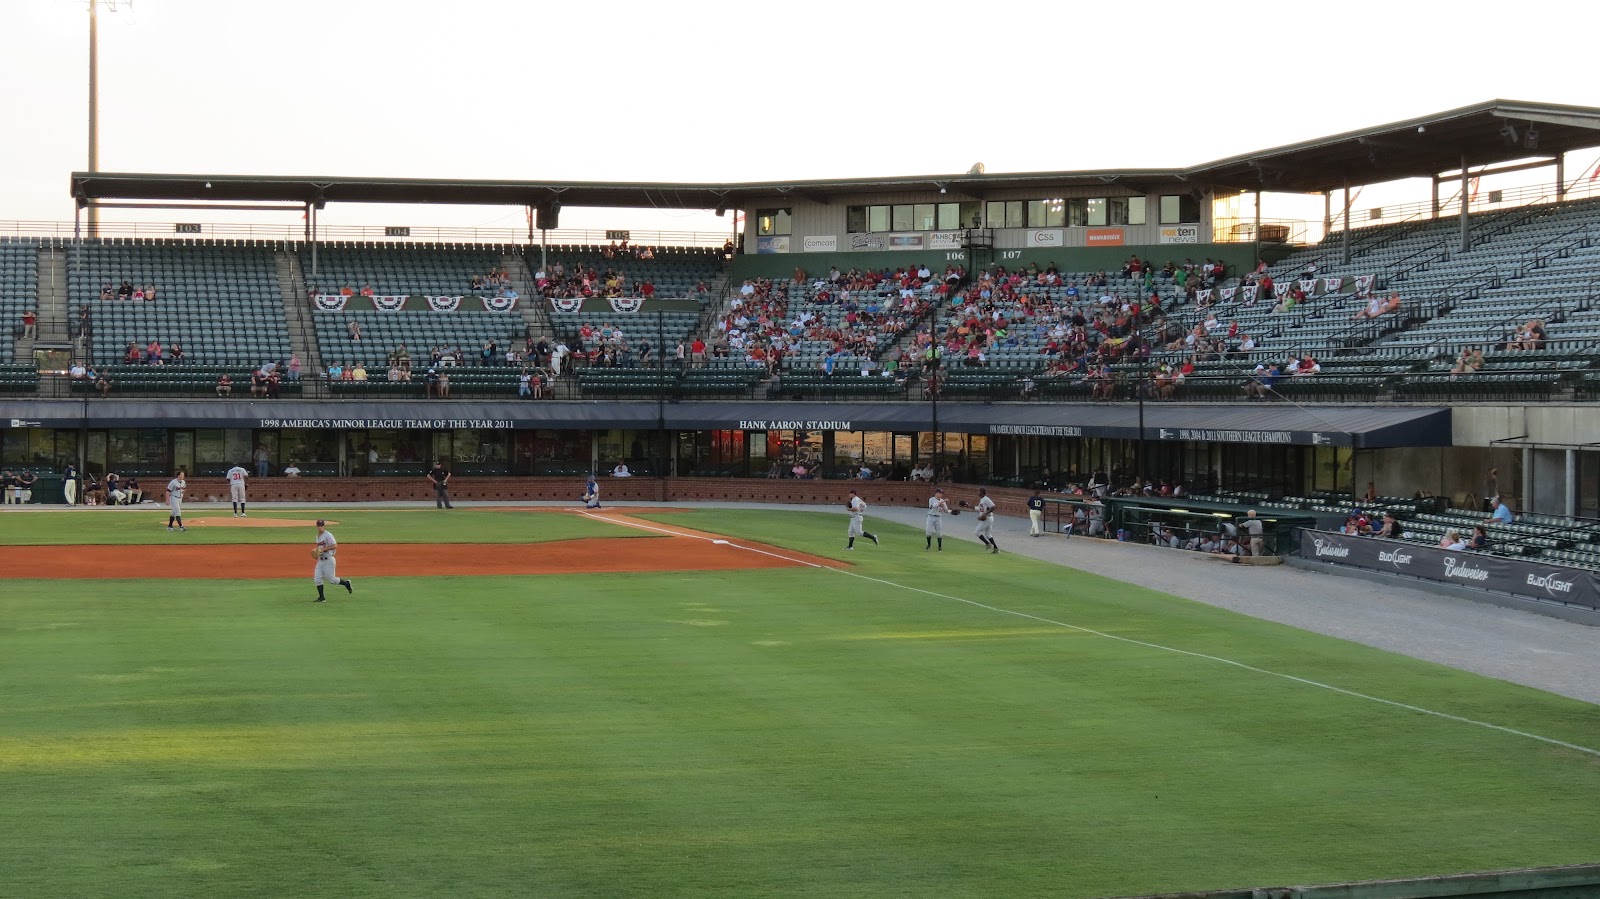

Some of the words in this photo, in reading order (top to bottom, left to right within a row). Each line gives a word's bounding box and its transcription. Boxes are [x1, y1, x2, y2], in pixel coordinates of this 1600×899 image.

[178, 224, 199, 233] 103
[387, 228, 408, 236] 104
[1177, 227, 1195, 236] ten
[946, 252, 964, 261] 106
[1002, 250, 1021, 259] 107
[260, 419, 280, 428] 1998
[281, 419, 330, 428] AMERICA'S
[332, 419, 365, 428] MINOR
[367, 419, 403, 428] LEAGUE
[404, 419, 431, 428] TEAM
[433, 419, 446, 428] OF
[448, 419, 467, 428] THE
[469, 419, 493, 428] YEAR
[494, 419, 514, 428] 2011
[739, 420, 767, 429] HANK
[769, 420, 803, 430] AARON
[806, 421, 851, 430] STADIUM
[1191, 430, 1201, 440] 2004
[1206, 431, 1216, 441] 2011
[1217, 431, 1242, 441] SOUTHERN
[1243, 431, 1261, 442] LEAGUE
[1261, 432, 1292, 443] CHAMPIONS
[1314, 539, 1349, 557] Budweiser
[1379, 551, 1392, 562] BUD
[1394, 554, 1412, 565] LIGHT
[1444, 557, 1489, 580] Budweiser
[1527, 573, 1546, 587] BUD
[1548, 577, 1573, 593] LIGHT
